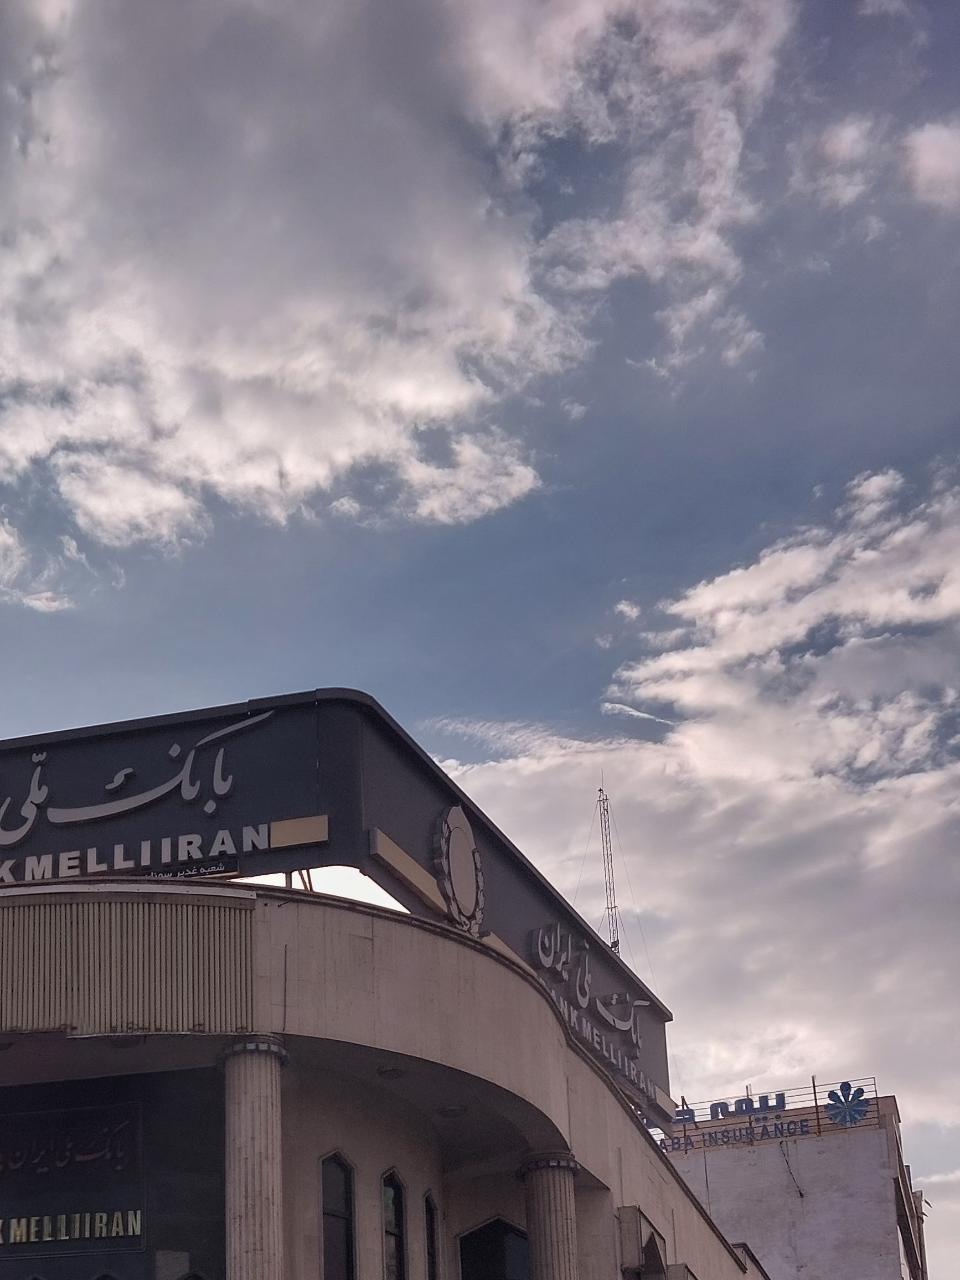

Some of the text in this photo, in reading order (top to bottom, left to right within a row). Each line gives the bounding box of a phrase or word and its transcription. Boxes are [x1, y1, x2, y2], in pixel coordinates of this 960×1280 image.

[47, 710, 274, 824] بانک
[24, 839, 150, 880] MELLI
[161, 823, 269, 864] IRAN
[582, 1017, 622, 1071] MELLI
[625, 1056, 657, 1100] IRAN
[9, 1213, 81, 1245] MELLI
[83, 1209, 142, 1240] IRAN
